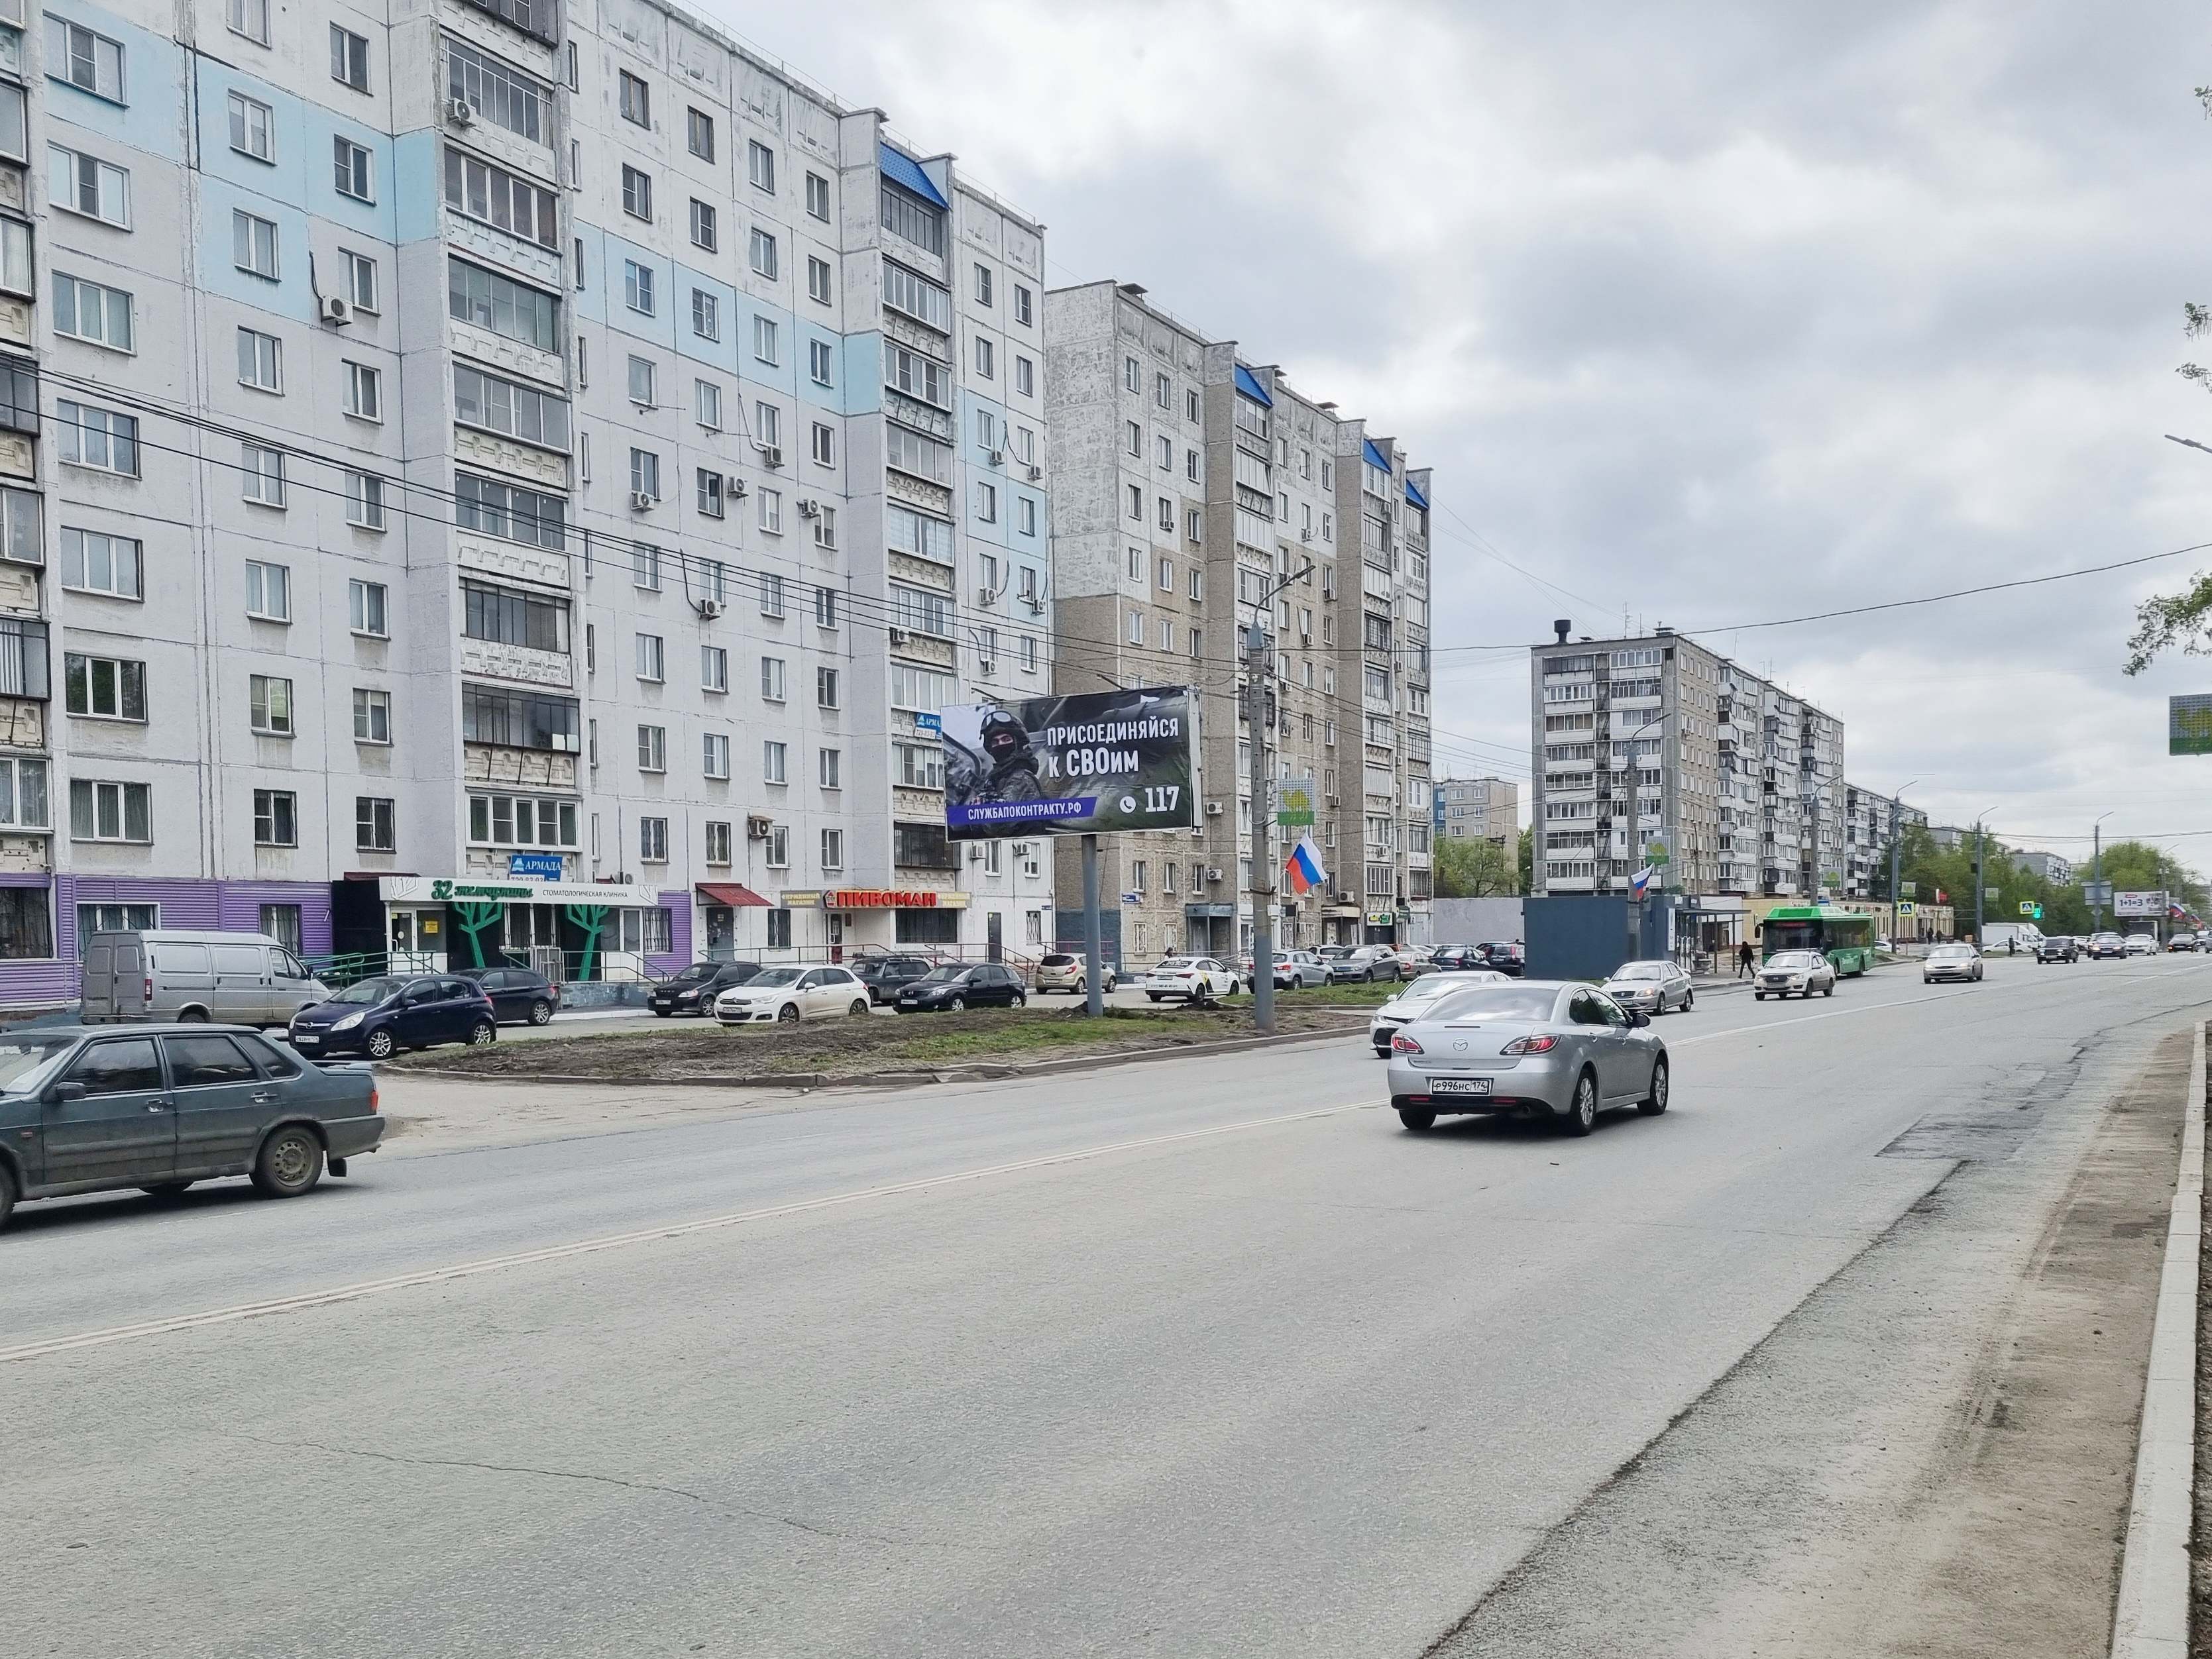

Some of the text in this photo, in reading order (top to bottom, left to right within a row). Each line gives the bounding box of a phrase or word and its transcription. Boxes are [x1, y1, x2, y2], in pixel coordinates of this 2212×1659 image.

[1047, 716, 1179, 746] ПРИСОЕДИНЯЙСЯ
[1144, 786, 1180, 812] 117
[968, 801, 1082, 820] СЛУЖБАПОКОНТРАКТУ.РФ
[525, 861, 561, 871] АРМАДА
[431, 880, 453, 900] 32
[836, 890, 936, 907] ПИВОМАН
[1434, 1081, 1470, 1091] Р996НС
